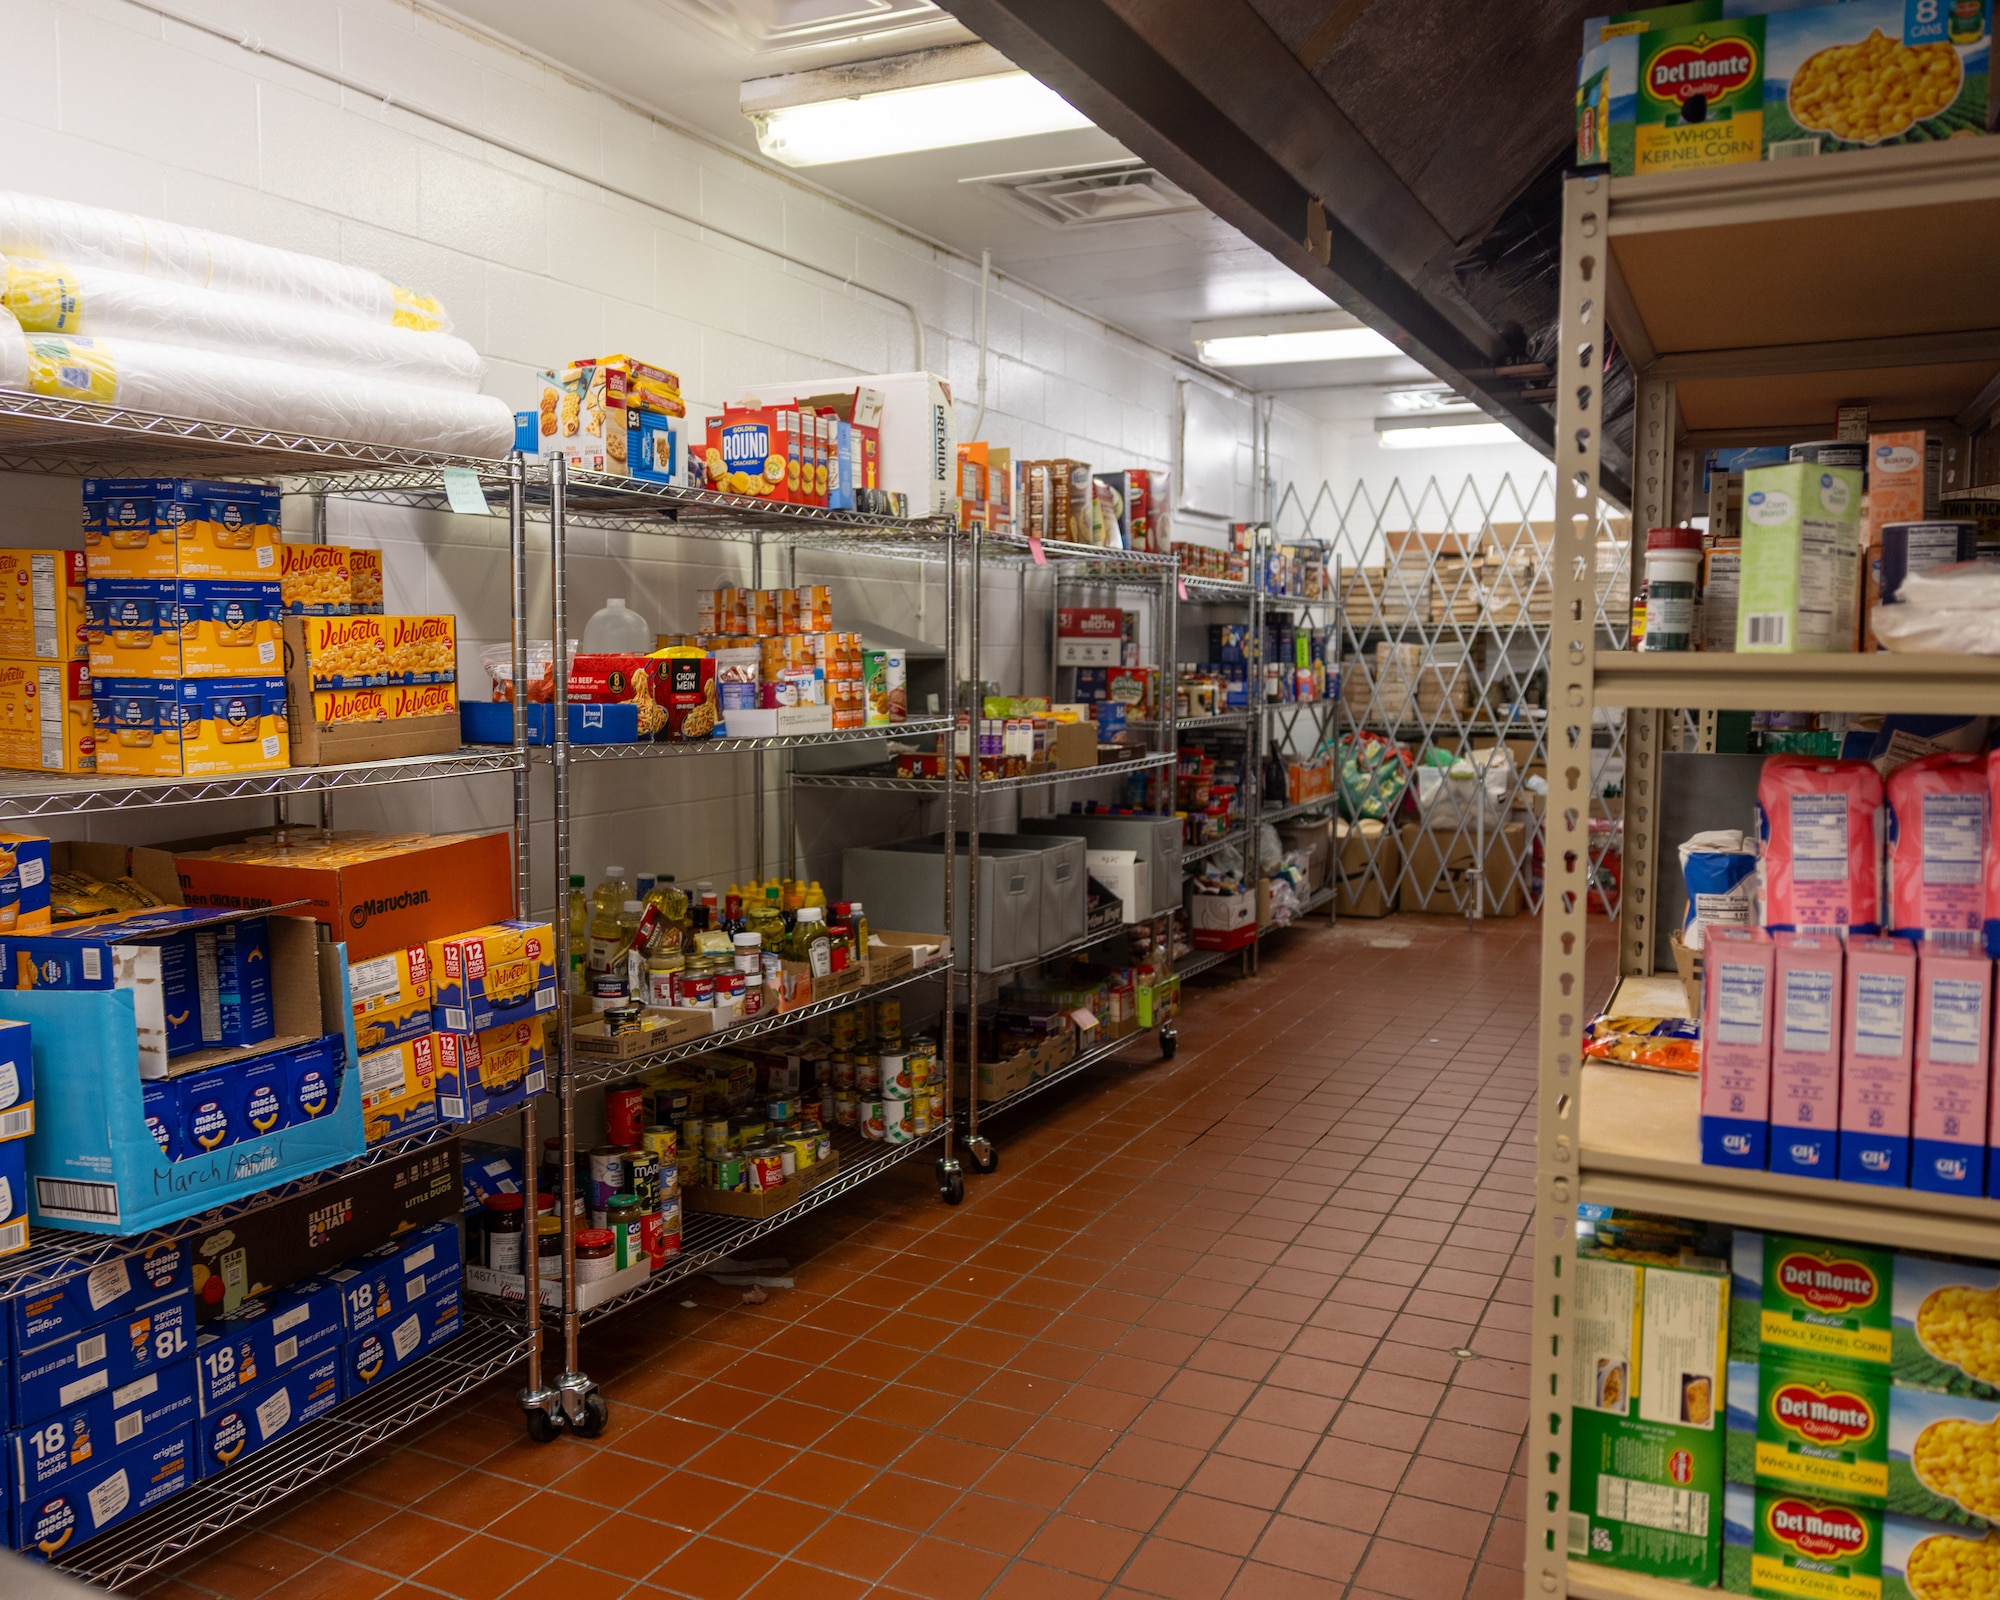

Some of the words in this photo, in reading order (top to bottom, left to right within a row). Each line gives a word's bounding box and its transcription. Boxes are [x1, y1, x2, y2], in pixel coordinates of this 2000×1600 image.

[1915, 1, 1938, 21] 8
[1911, 22, 1942, 38] CANS
[1655, 64, 1686, 84] Del
[1688, 56, 1750, 81] Monte
[1680, 82, 1720, 98] Quality
[1673, 125, 1734, 144] WHOLE
[1642, 142, 1701, 164] KERNEL
[1704, 139, 1754, 158] CORN
[628, 411, 637, 427] 10
[723, 432, 768, 460] ROUND
[937, 404, 946, 480] PREMIUM
[1884, 456, 1913, 465] Baking
[162, 483, 173, 491] pack
[267, 490, 279, 498] pack
[1760, 509, 1788, 517] Starch
[1942, 503, 1970, 516] TWIN
[74, 553, 84, 567] 8
[281, 546, 343, 575] Velveeta
[350, 552, 376, 570] eeta
[1060, 614, 1067, 626] 3
[1081, 620, 1115, 629] BROTH
[320, 619, 380, 650] Velveeta
[394, 618, 448, 648] Velveeta
[80, 666, 89, 680] 8
[615, 673, 619, 685] 8
[676, 673, 696, 681] CHOW
[677, 682, 695, 690] MEIN
[324, 690, 382, 722] Velveeta
[395, 684, 448, 718] Velveeta
[210, 894, 240, 908] CHICKEN
[243, 897, 272, 908] FLAVOR
[409, 946, 426, 965] 12
[444, 946, 458, 961] 12
[466, 944, 483, 961] 12
[411, 963, 426, 973] PACK
[446, 959, 459, 967] PACK
[468, 959, 484, 970] PACK
[411, 971, 426, 980] CUPS
[468, 967, 486, 977] CUPS
[494, 962, 527, 988] Velveeta
[415, 1039, 431, 1056] 12
[440, 1036, 454, 1050] 12
[463, 1035, 478, 1050] 12
[417, 1055, 432, 1065] PACK
[441, 1048, 455, 1056] PACK
[442, 1054, 456, 1062] CUPS
[465, 1048, 480, 1059] PACK
[417, 1063, 433, 1072] CUPS
[465, 1056, 481, 1066] CUPS
[488, 1049, 521, 1074] Velveeta
[234, 1157, 278, 1180] Millville
[405, 1192, 429, 1208] LITTLE
[430, 1183, 451, 1197] DUOS
[314, 1200, 352, 1221] LITTLE
[628, 1222, 640, 1234] GO
[224, 1255, 230, 1263] 5
[231, 1251, 242, 1261] LB
[468, 1269, 497, 1284] 14871
[1784, 1265, 1812, 1286] Del
[1814, 1270, 1871, 1295] Monte
[348, 1284, 372, 1312] 18
[436, 1292, 458, 1307] original
[1808, 1289, 1844, 1306] Quality
[154, 1306, 182, 1322] inside
[353, 1306, 374, 1322] boxes
[26, 1316, 63, 1337] original
[154, 1316, 183, 1332] boxes
[354, 1315, 374, 1331] inside
[155, 1326, 188, 1359] 18
[1766, 1324, 1805, 1339] WHOLE
[1810, 1331, 1848, 1346] KERNEL
[1853, 1339, 1888, 1353] CORN
[206, 1347, 235, 1378] 18
[309, 1362, 335, 1381] original
[211, 1372, 236, 1389] boxes
[212, 1382, 236, 1399] inside
[144, 1414, 151, 1423] DO
[152, 1409, 161, 1419] NOT
[162, 1406, 171, 1415] LIFT
[172, 1402, 178, 1411] BY
[178, 1396, 192, 1407] FLAPS
[1780, 1397, 1806, 1418] Del
[1808, 1402, 1868, 1429] Monte
[1803, 1420, 1840, 1439] Quality
[30, 1423, 65, 1459] 18
[153, 1439, 185, 1460] original
[37, 1451, 67, 1471] boxes
[38, 1462, 67, 1482] inside
[1760, 1455, 1802, 1473] WHOLE
[1805, 1464, 1845, 1480] KERNEL
[1848, 1470, 1884, 1488] CORN
[97, 1485, 106, 1494] no
[98, 1496, 108, 1504] no
[101, 1507, 111, 1515] no
[1776, 1511, 1801, 1532] Del
[1803, 1516, 1862, 1544] Monte
[1798, 1533, 1836, 1552] Quality
[1756, 1568, 1797, 1585] WHOLE
[1800, 1576, 1840, 1594] KERNEL
[1843, 1584, 1879, 1600] CORN
